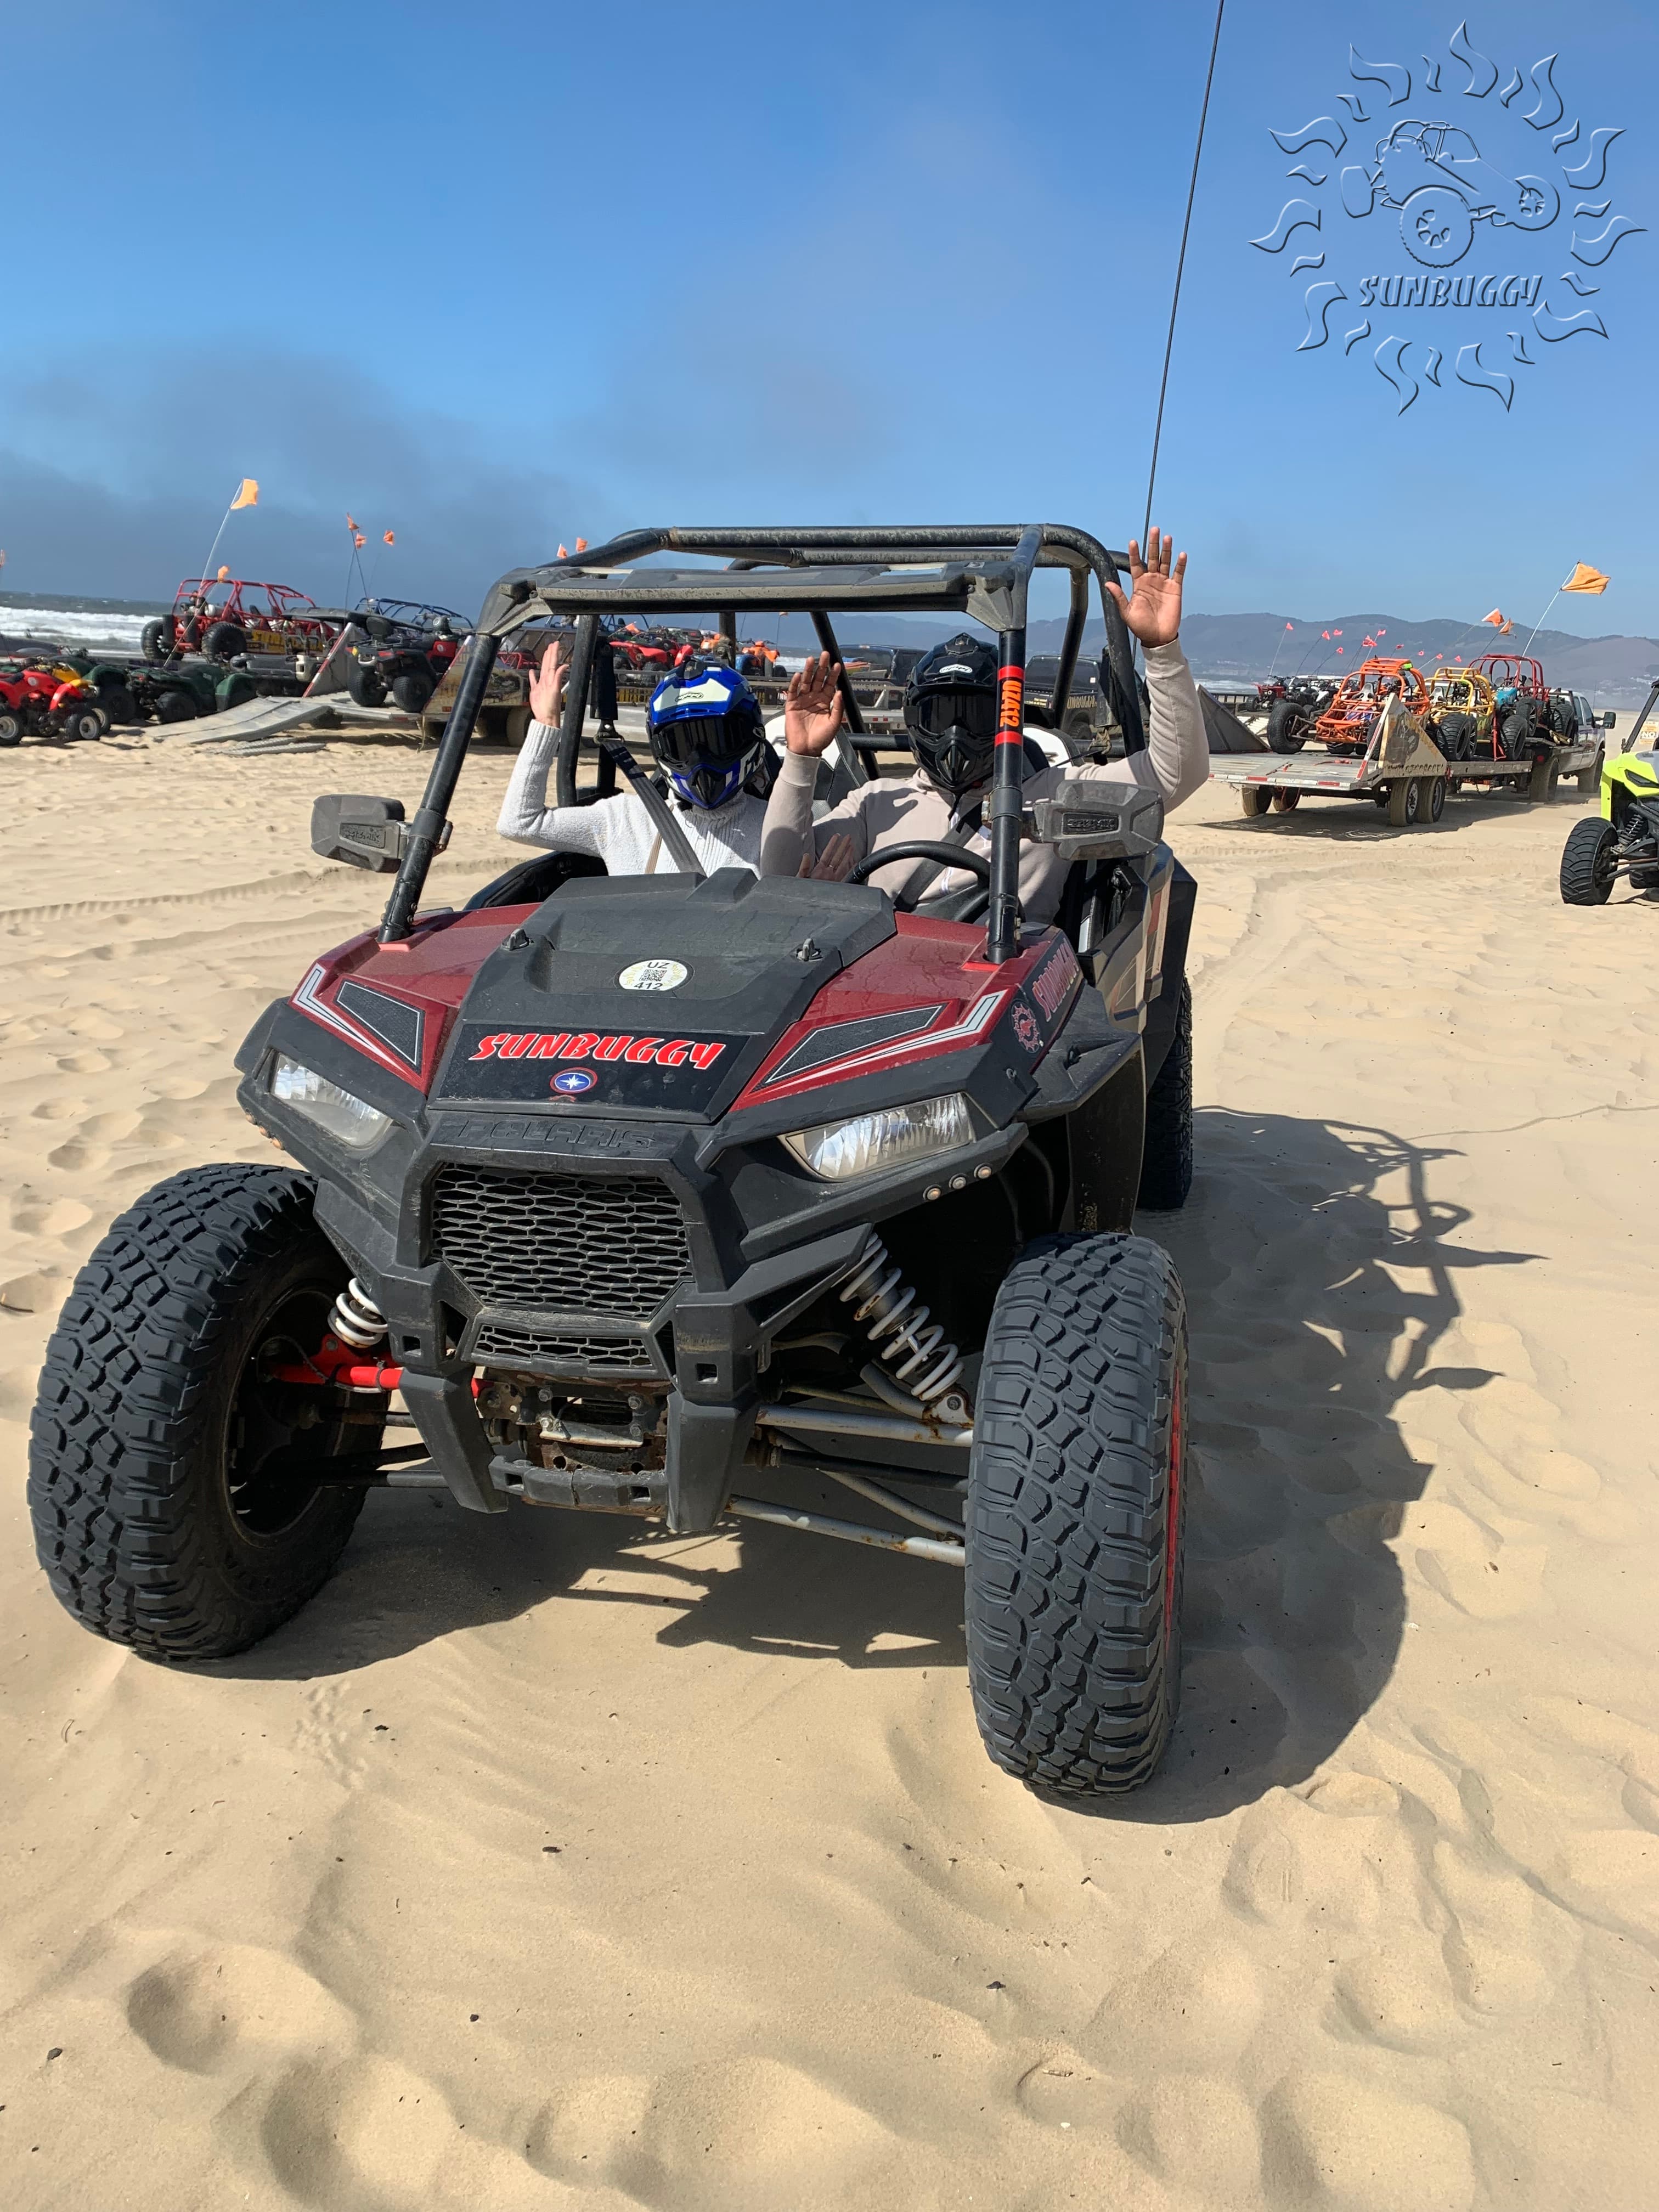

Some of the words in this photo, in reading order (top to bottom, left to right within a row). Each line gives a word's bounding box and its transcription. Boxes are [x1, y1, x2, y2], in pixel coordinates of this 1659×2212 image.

[1000, 680, 1022, 727] UZ412
[634, 982, 663, 990] 412
[469, 1033, 726, 1070] SUNBUGGY
[458, 1119, 656, 1149] POLARIS
